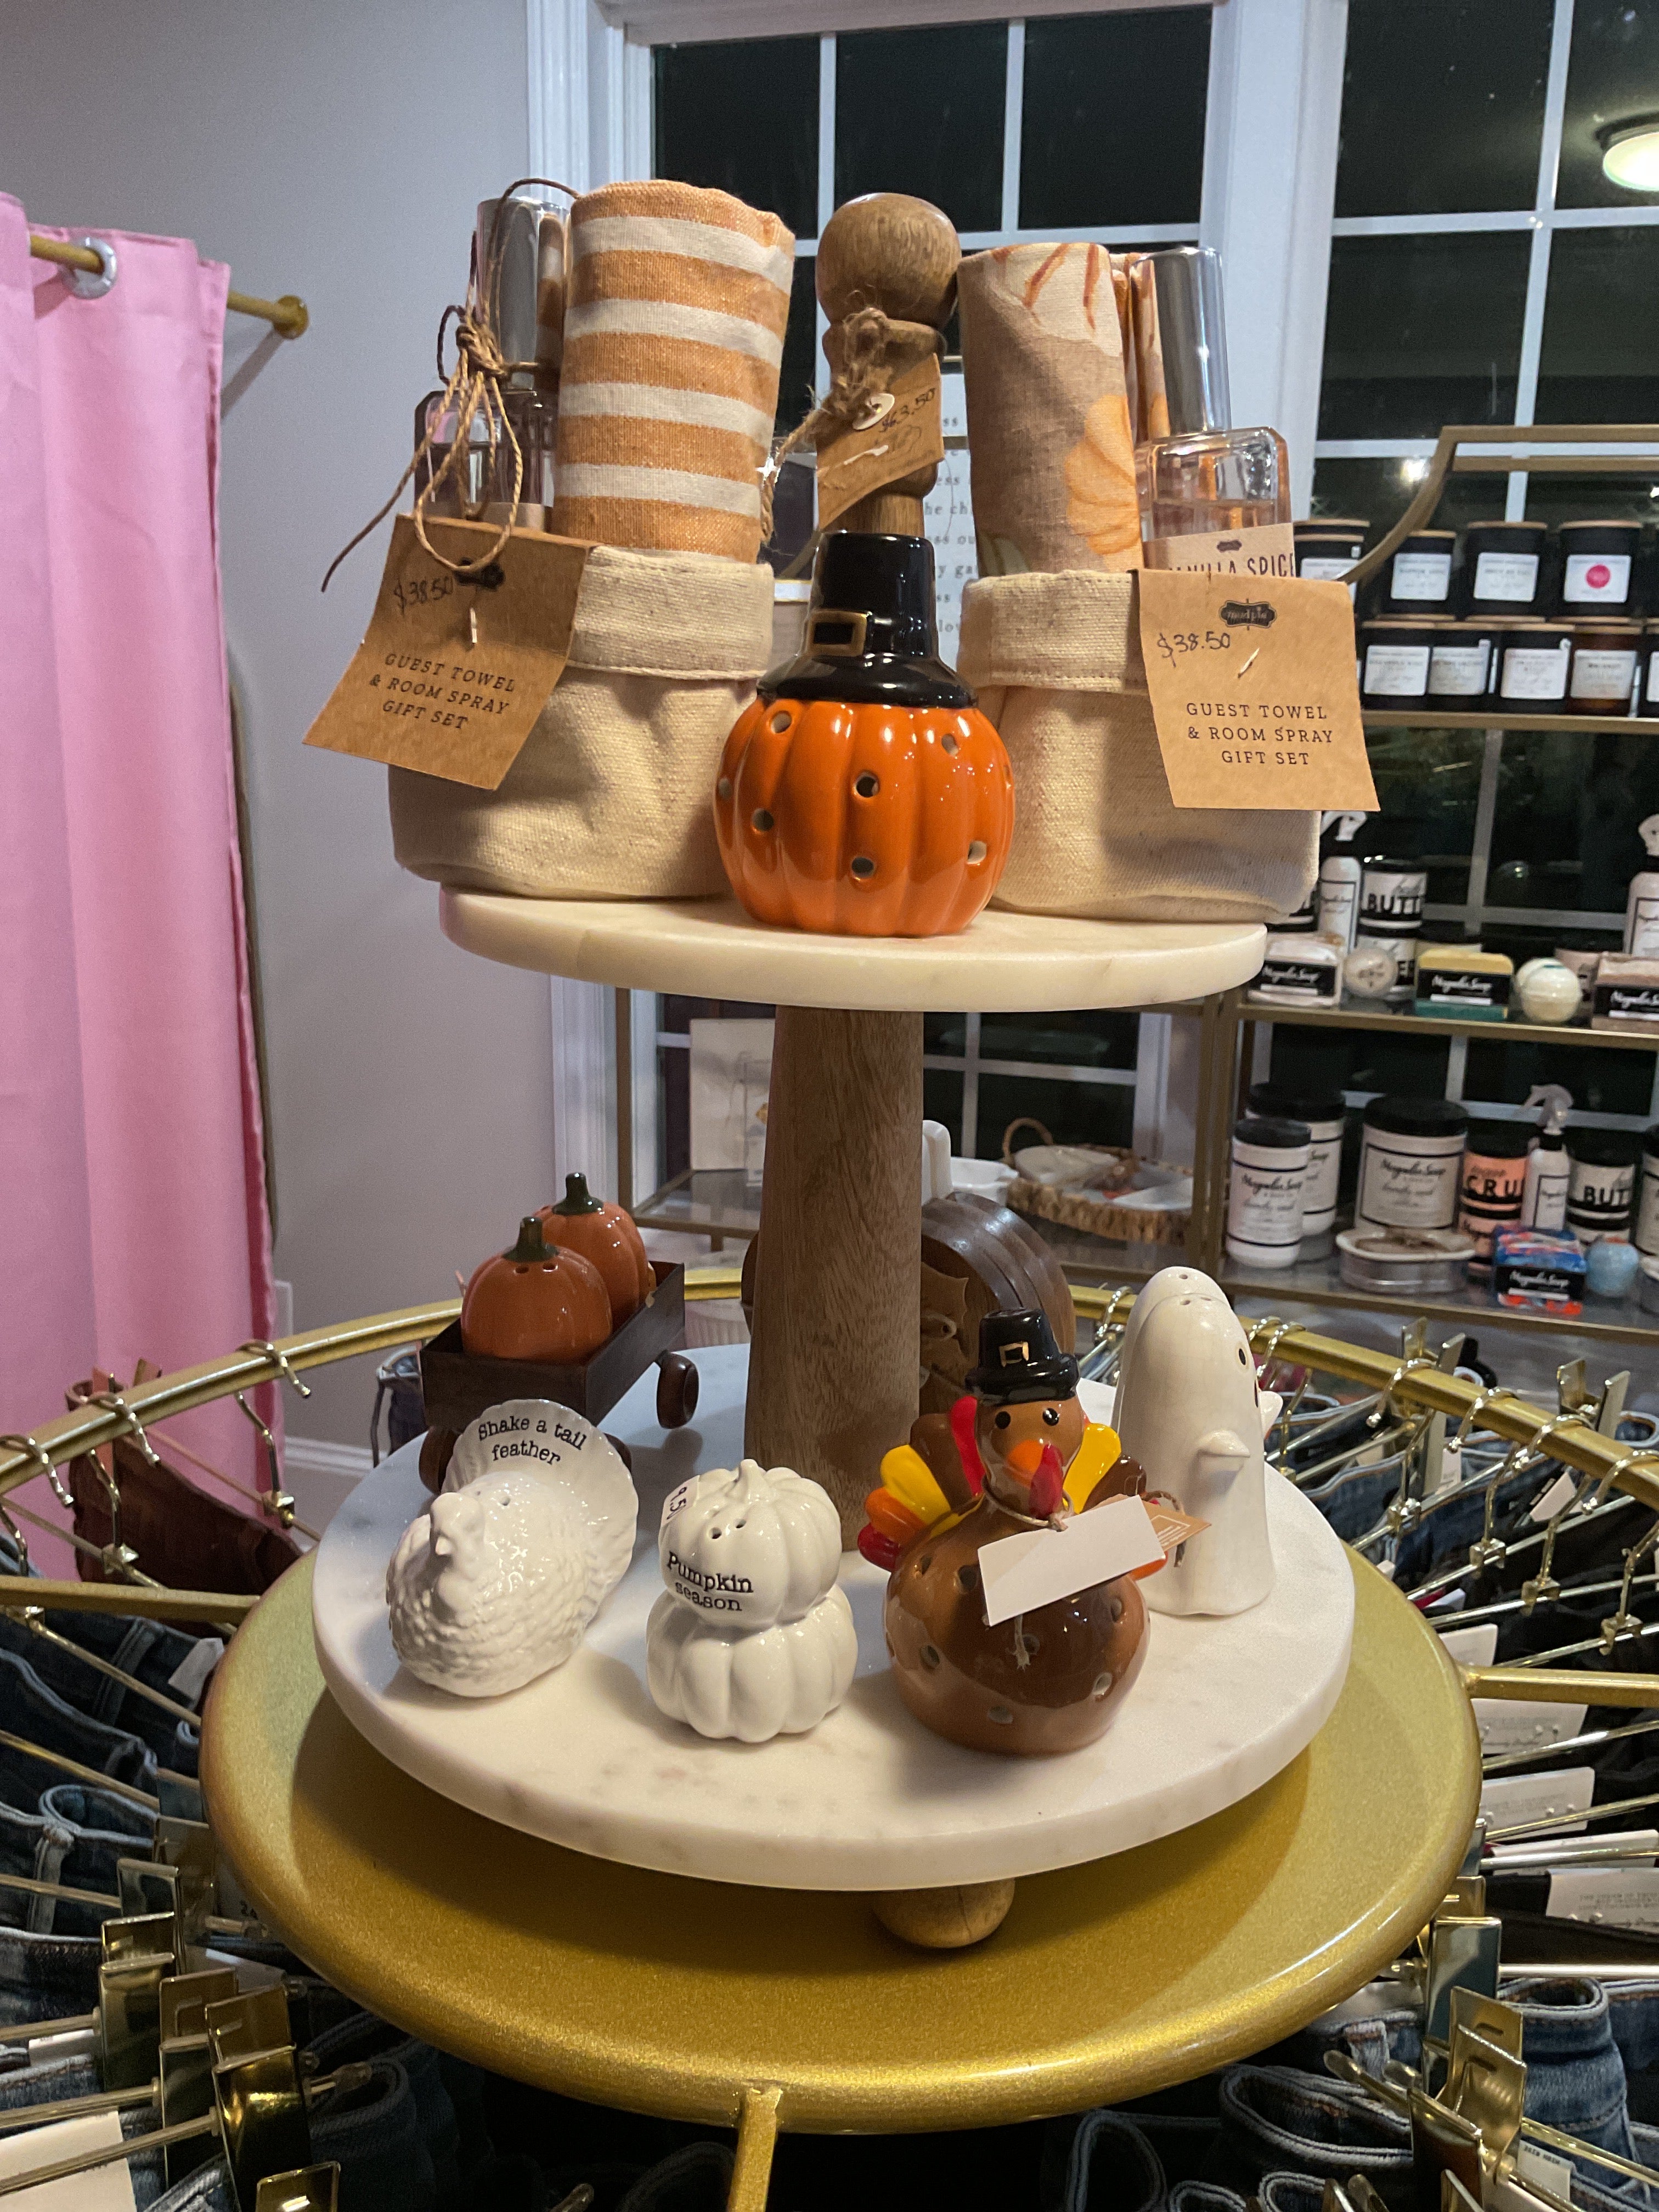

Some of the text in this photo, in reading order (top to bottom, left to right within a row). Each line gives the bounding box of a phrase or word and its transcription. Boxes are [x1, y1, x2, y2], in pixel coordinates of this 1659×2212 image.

[1157, 631, 1231, 668] $38.50
[385, 653, 515, 692] GUEST TOWEL
[369, 674, 510, 714] & ROOM SPRAY
[382, 700, 469, 729] GIFT SET
[1187, 703, 1327, 719] GUEST TOWEL
[1188, 726, 1333, 743] & ROOM SPRAY
[1222, 751, 1309, 765] GIFT SET
[478, 1415, 587, 1451] Shake a tail
[492, 1440, 561, 1465] feather
[666, 1551, 754, 1593] Pumpkin
[675, 1582, 743, 1611] season
